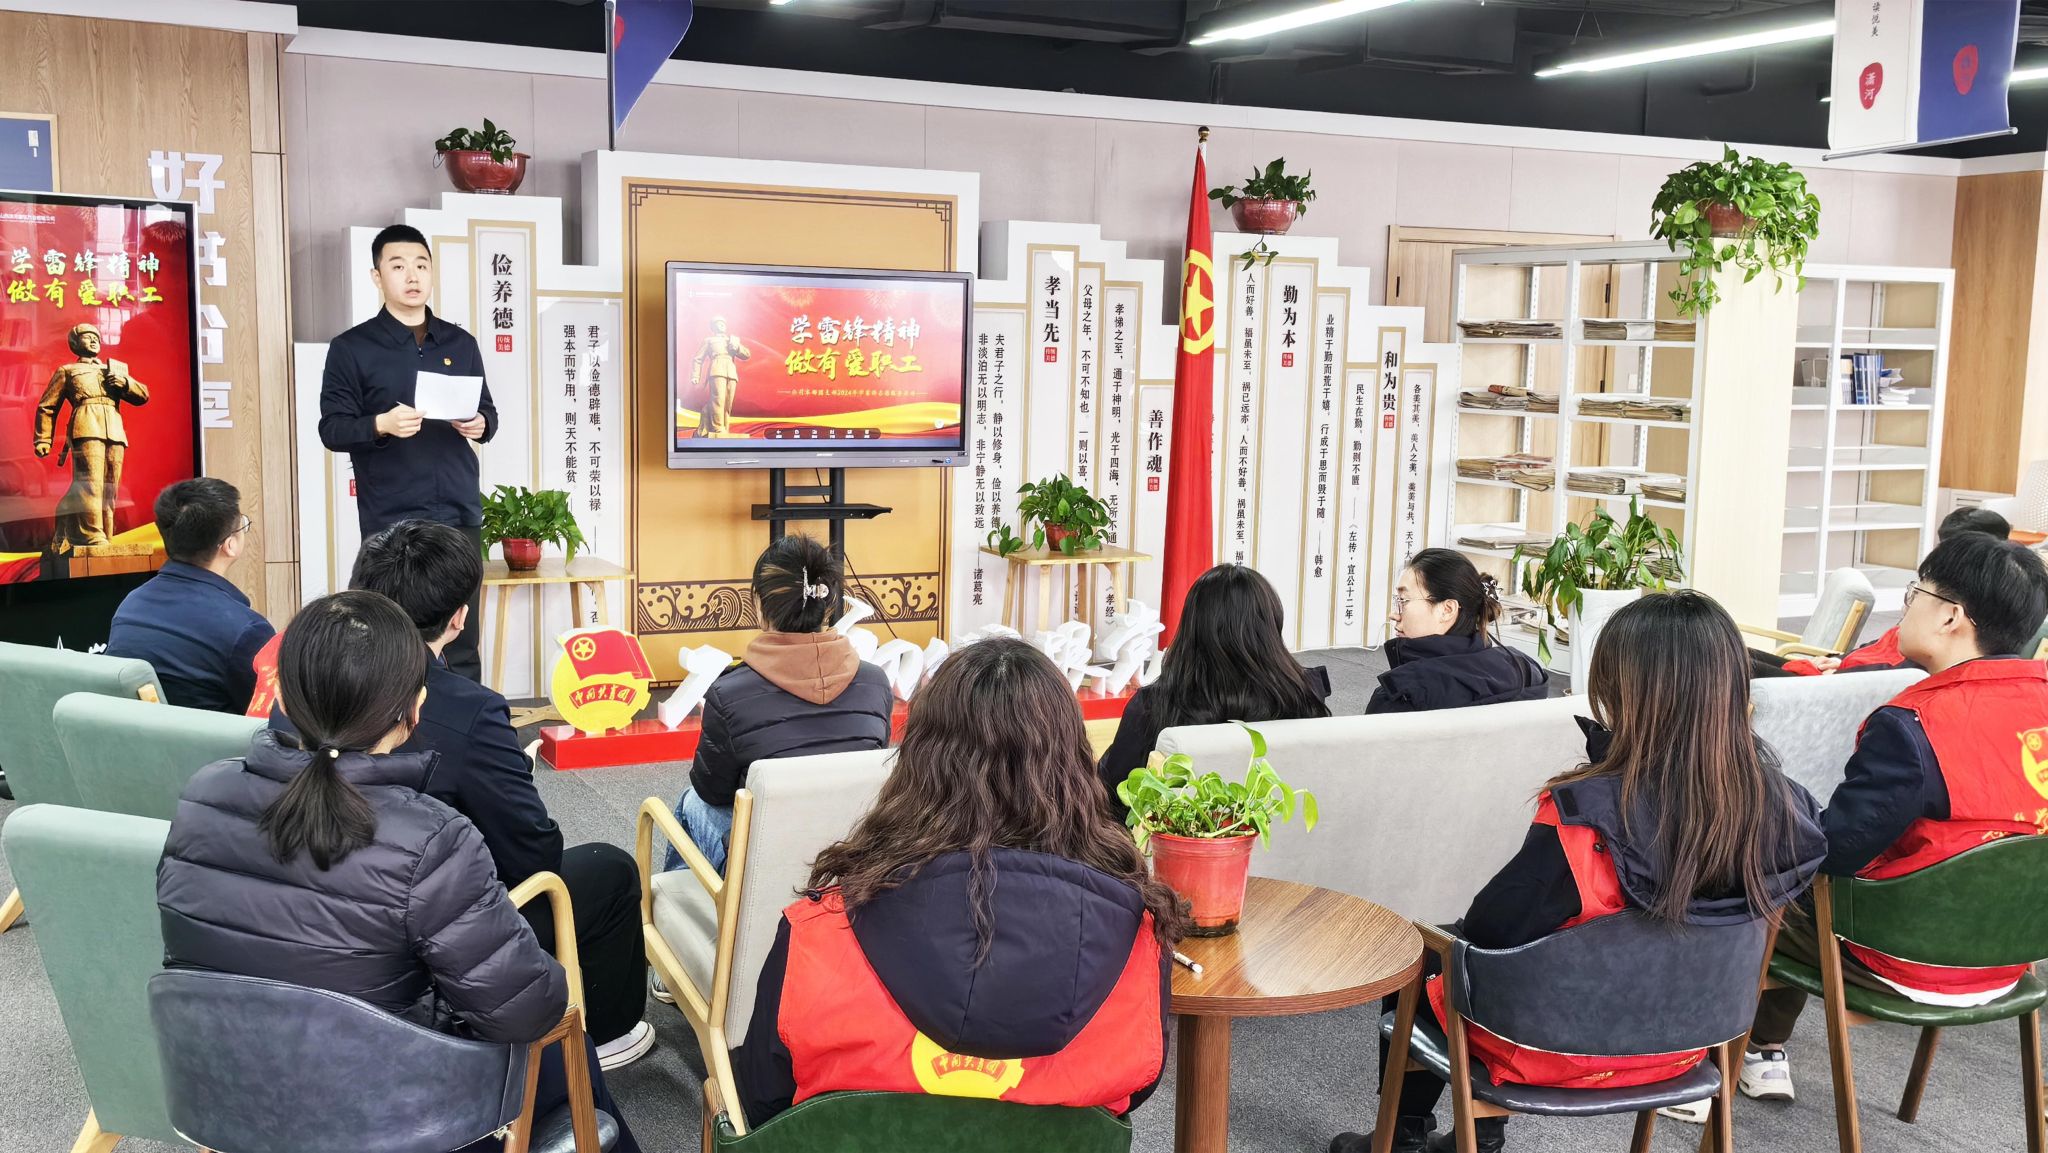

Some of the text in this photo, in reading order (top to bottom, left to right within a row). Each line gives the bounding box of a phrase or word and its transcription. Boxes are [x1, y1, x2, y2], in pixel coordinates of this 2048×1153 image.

[11, 246, 160, 282] 学雷锋精神
[7, 277, 163, 308] 做有爱职工
[491, 253, 513, 329] 俭养德
[1043, 275, 1061, 343] 孝当先
[790, 313, 921, 349] 学雷锋精神
[1281, 284, 1298, 348] 勤为本
[785, 347, 923, 380] 做有爱职工
[1382, 351, 1398, 411] 和为贵
[1147, 409, 1163, 473] 善作魂
[575, 684, 630, 705] 中国共青团
